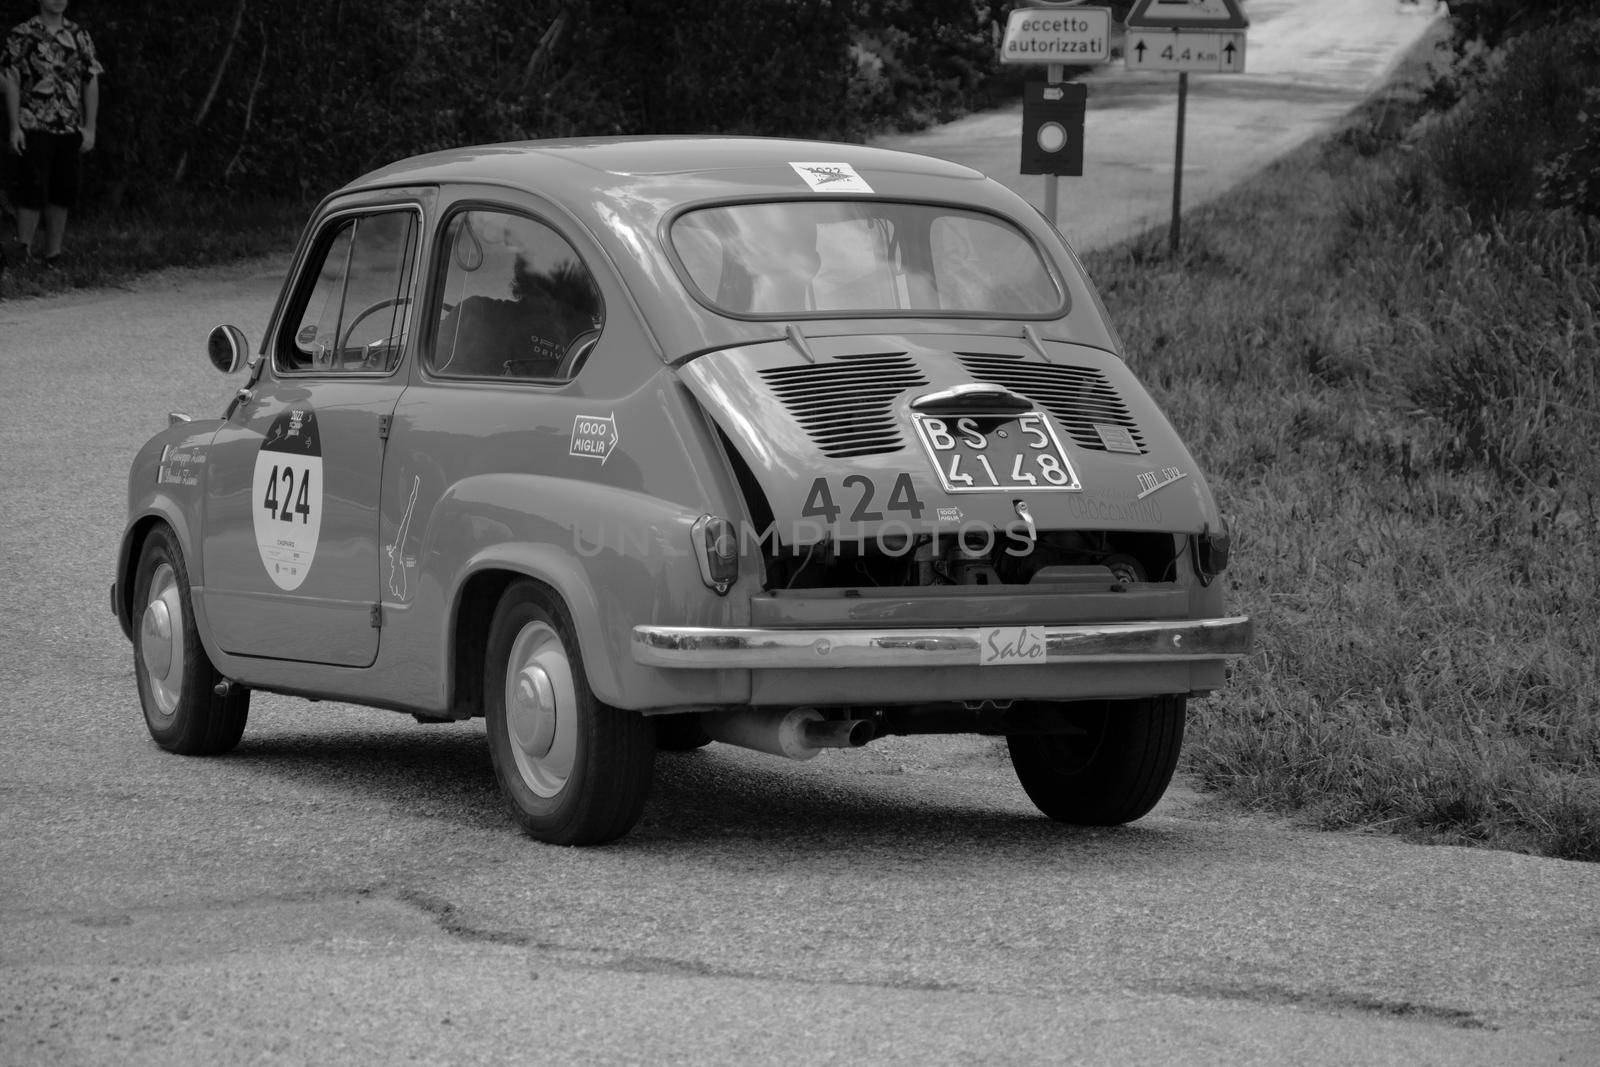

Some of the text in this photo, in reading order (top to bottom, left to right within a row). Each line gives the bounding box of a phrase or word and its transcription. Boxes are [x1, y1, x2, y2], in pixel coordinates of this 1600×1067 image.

[1022, 18, 1089, 33] eccetto
[1008, 37, 1103, 54] autorizzati
[579, 422, 607, 436] 1000
[922, 417, 1049, 450] BS 5
[573, 438, 605, 454] MIGLIA
[1137, 472, 1159, 491] FIAT
[264, 465, 310, 525] 424
[801, 472, 925, 524] 424
[986, 628, 1042, 662] Salò
